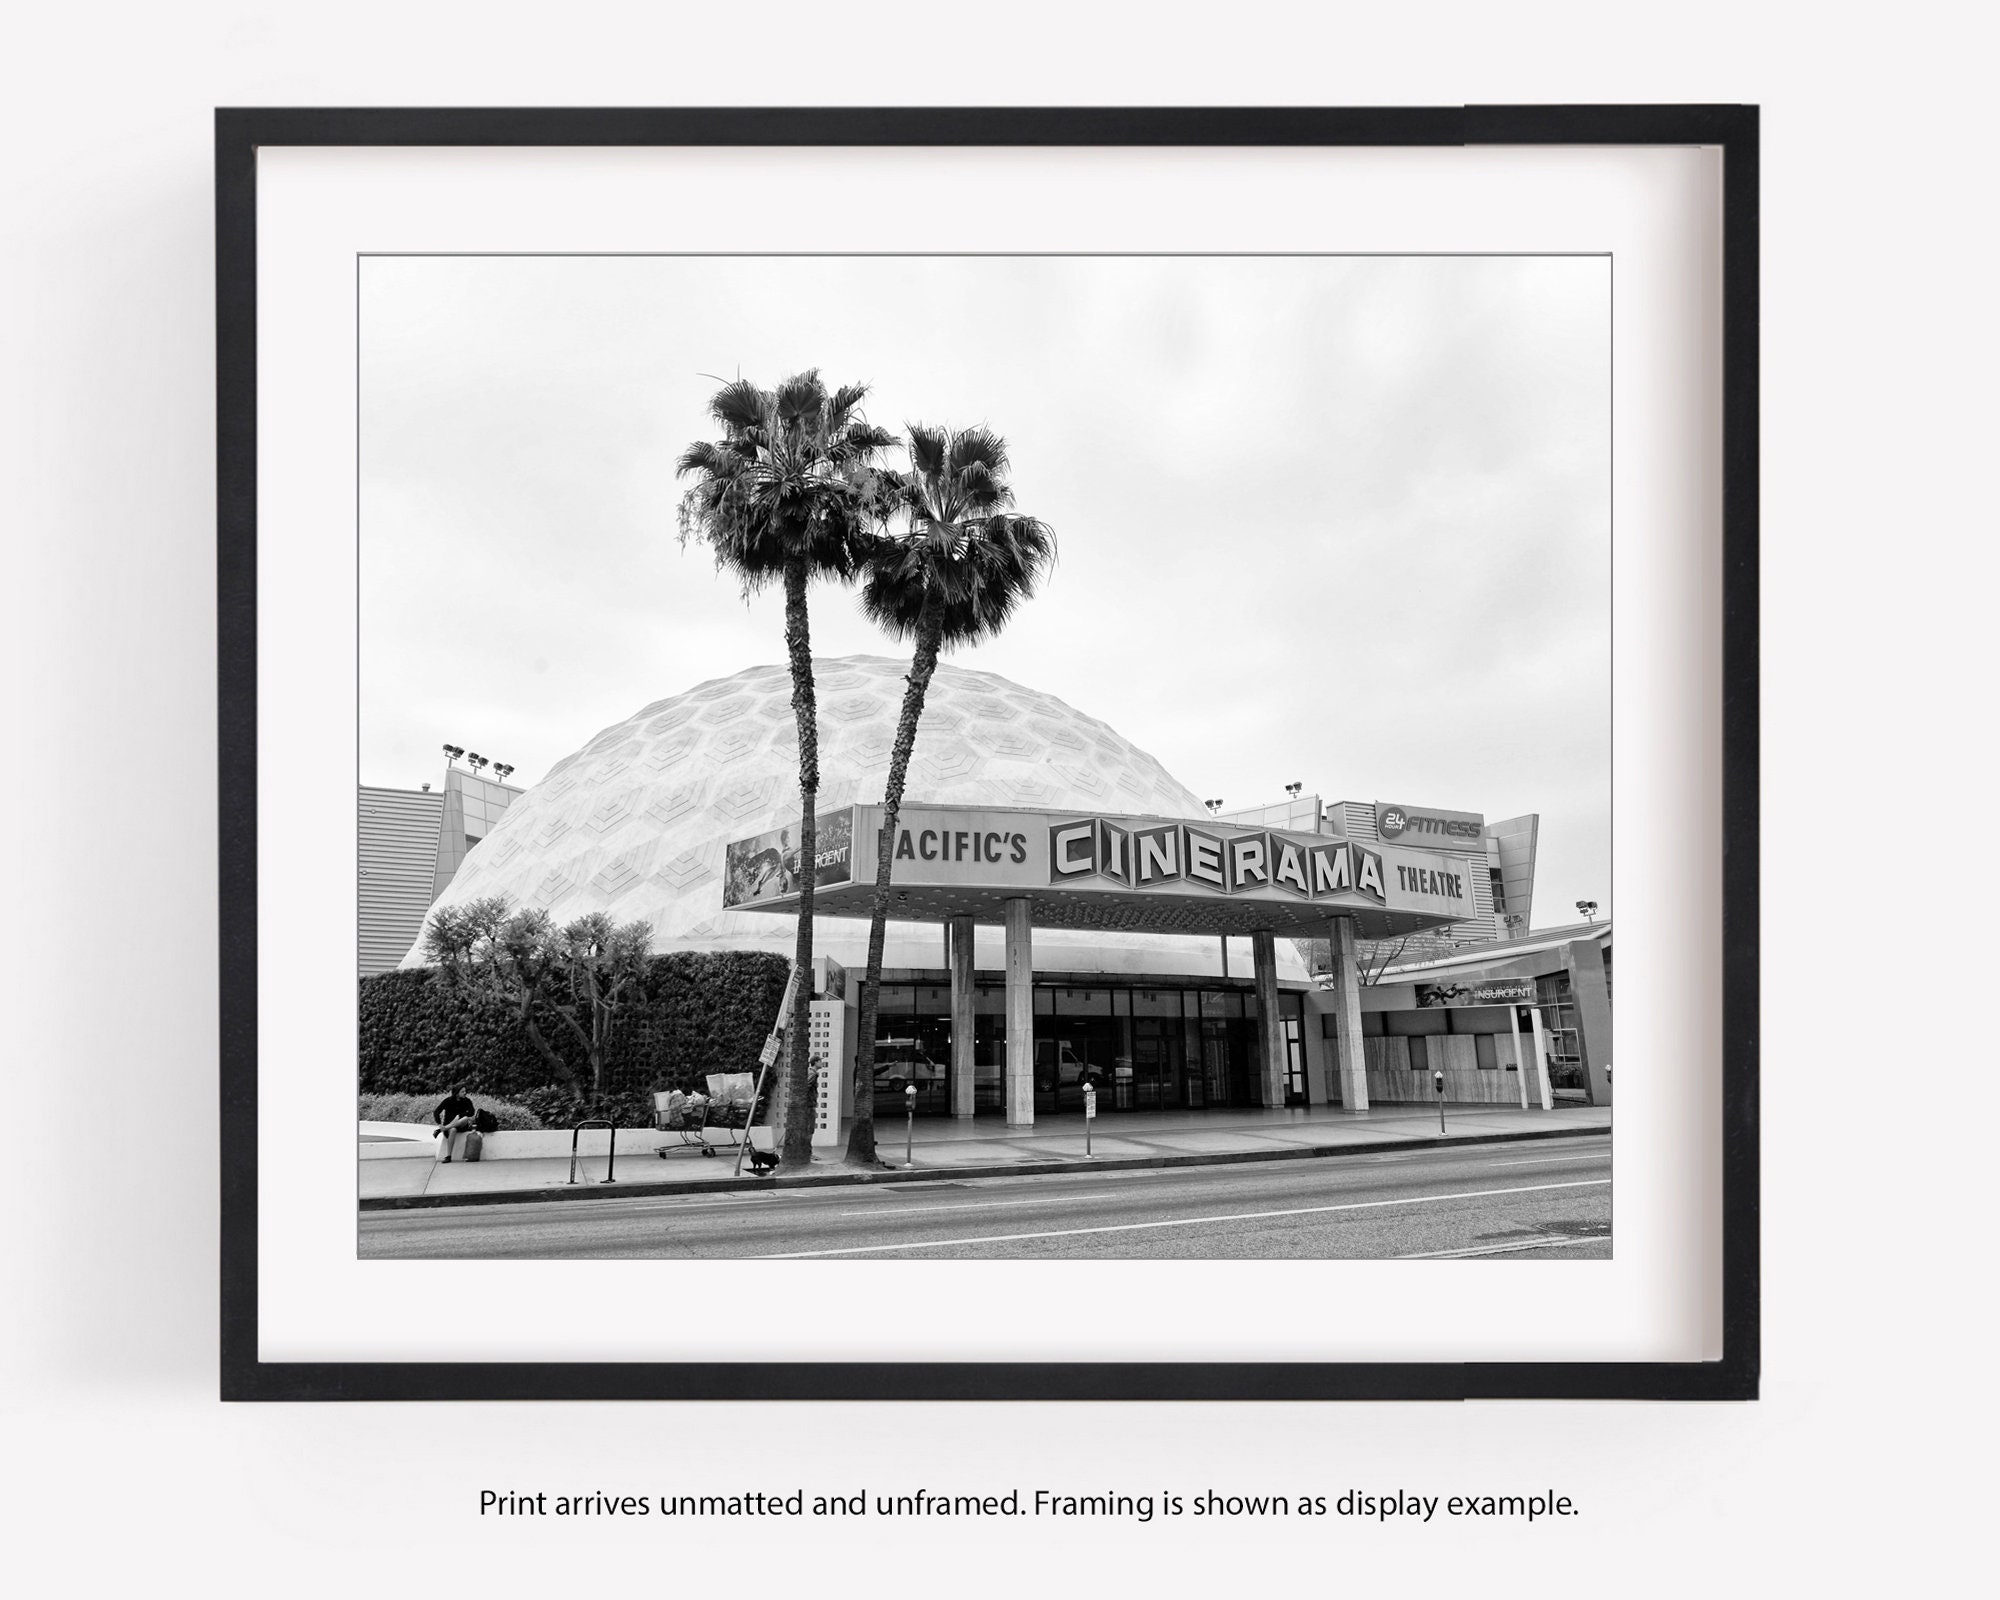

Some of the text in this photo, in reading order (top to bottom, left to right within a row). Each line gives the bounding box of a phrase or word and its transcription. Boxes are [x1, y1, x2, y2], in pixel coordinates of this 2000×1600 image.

[1385, 813, 1406, 830] 24
[1405, 816, 1482, 838] FITNESS
[793, 846, 849, 875] IRGENT
[877, 825, 1463, 899] ACIFIC'S CINERAMA THEATRE
[1474, 987, 1533, 1000] INSURGENT
